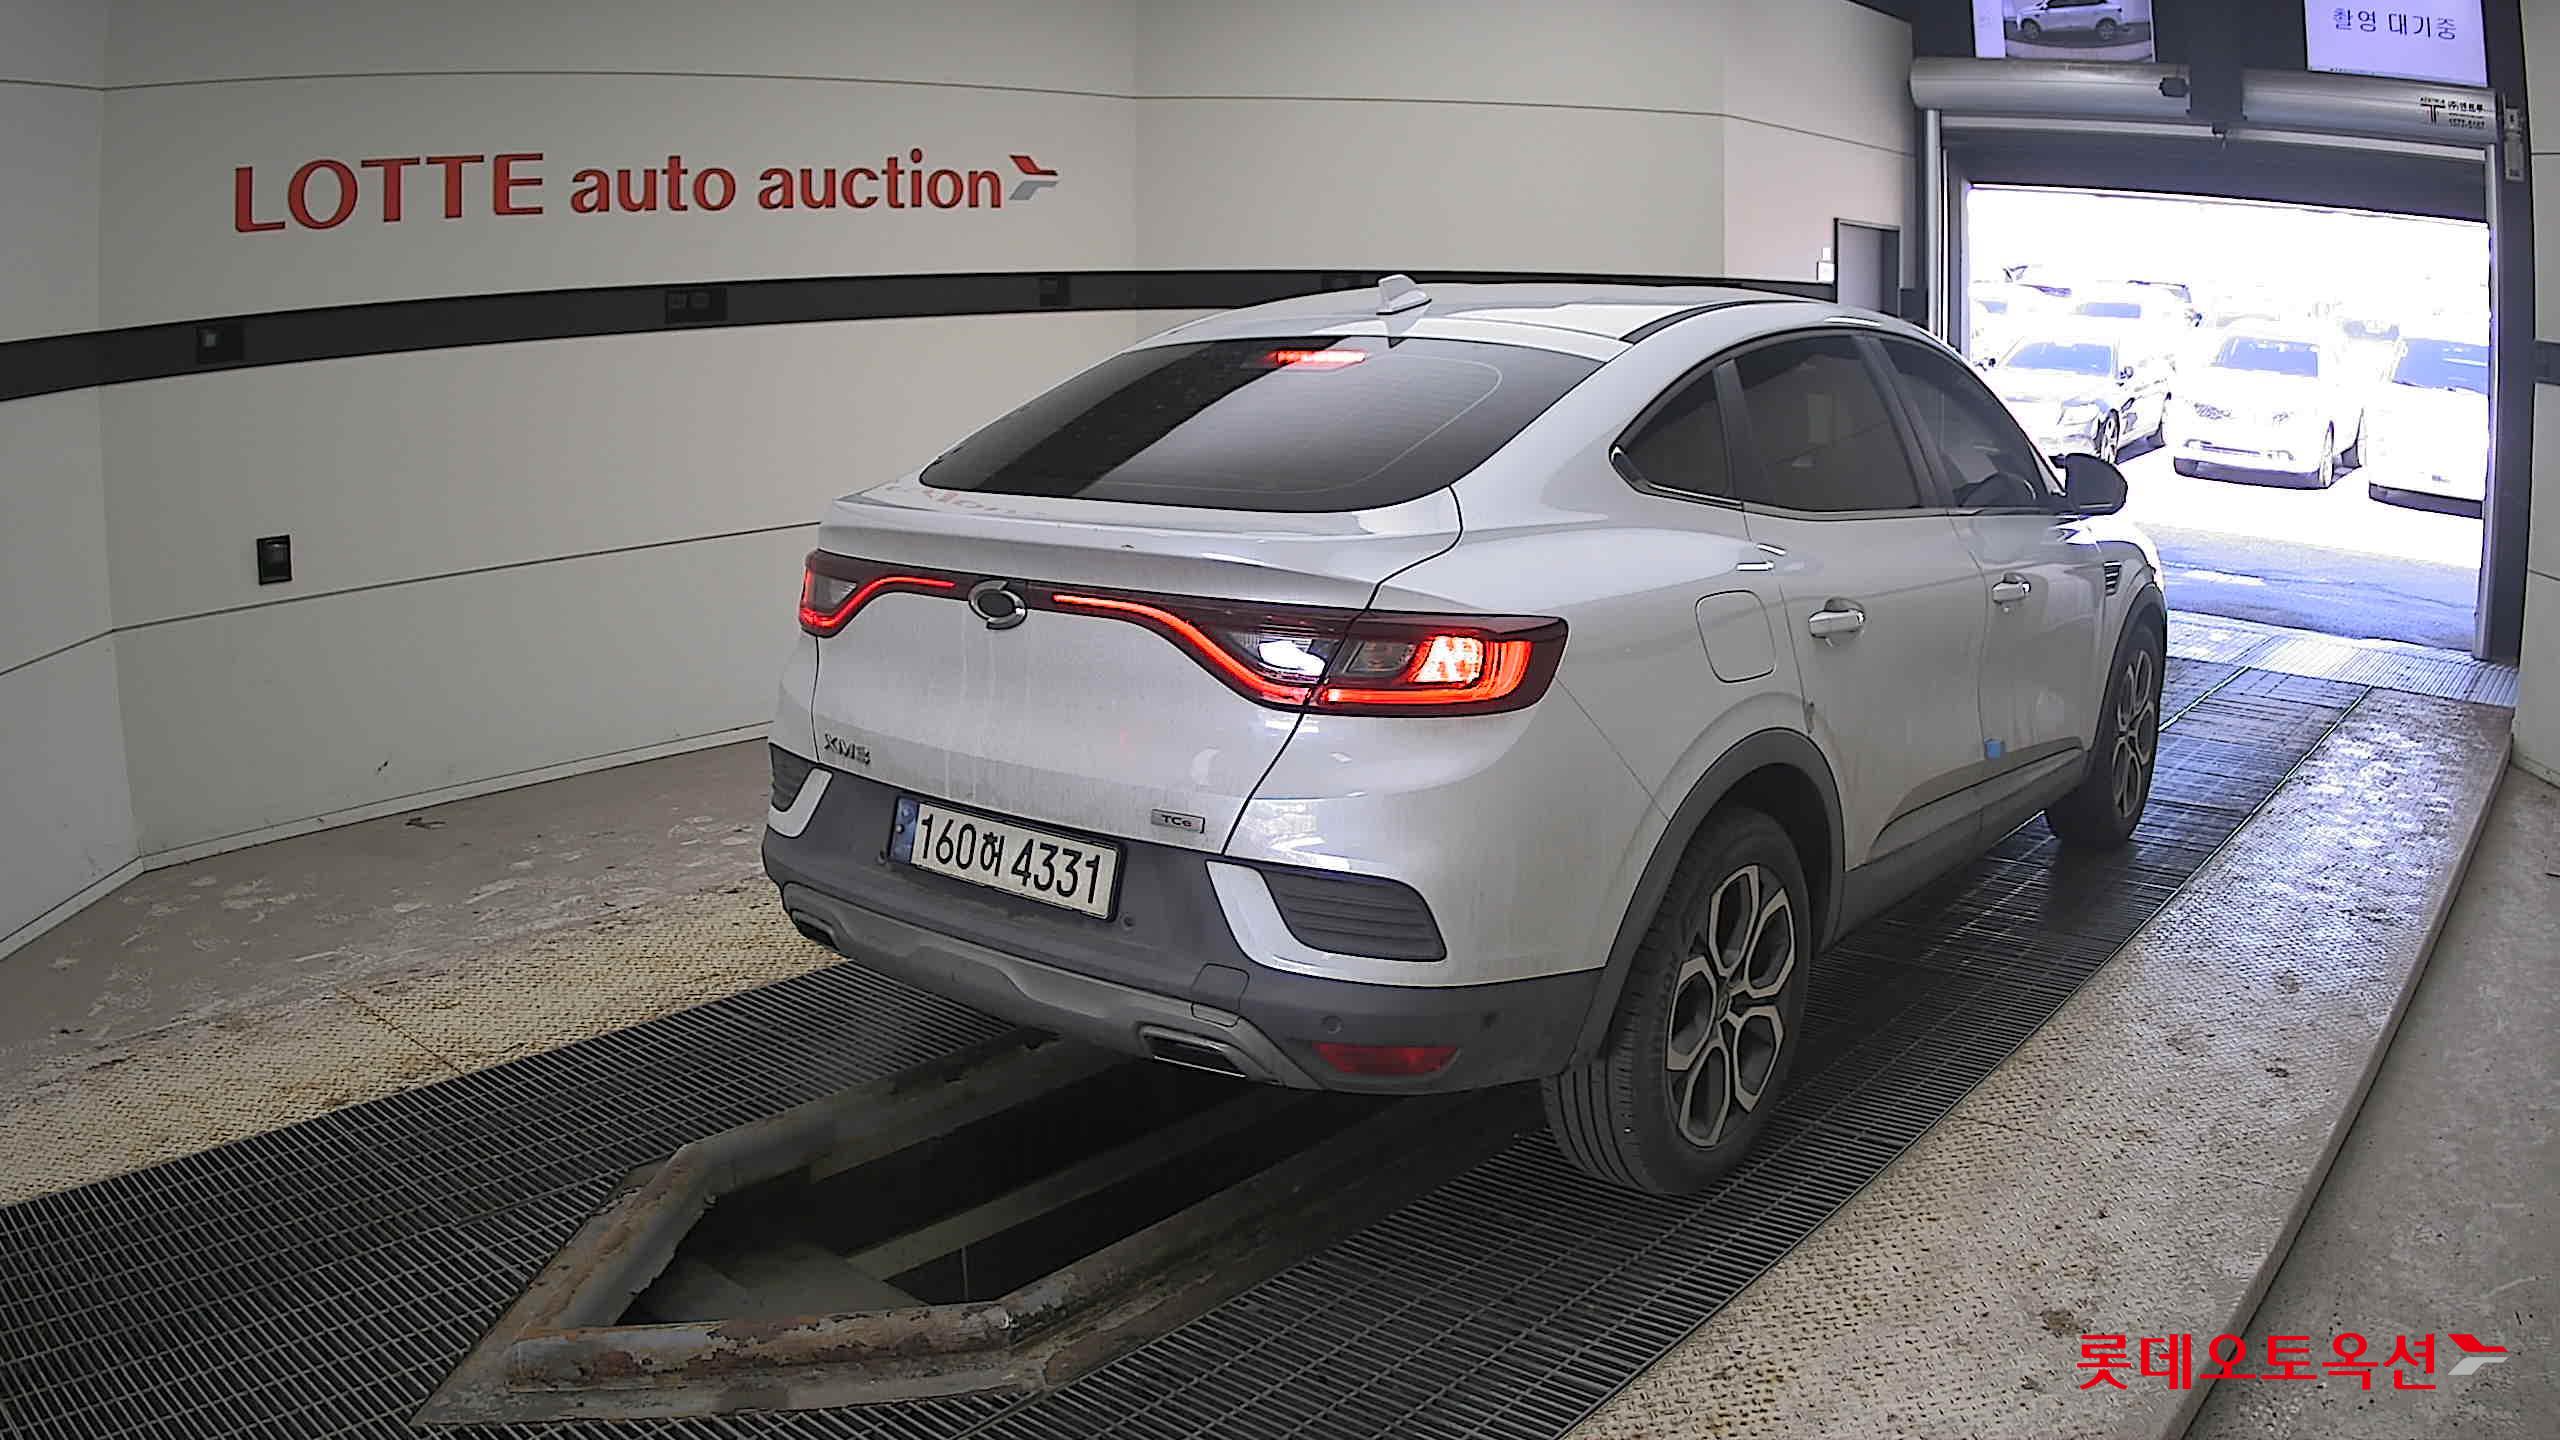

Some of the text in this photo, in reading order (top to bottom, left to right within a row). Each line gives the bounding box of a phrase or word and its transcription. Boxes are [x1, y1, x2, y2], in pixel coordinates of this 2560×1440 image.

[2388, 13, 2456, 40] 대기중
[235, 148, 1004, 233] LOTTE auto auction
[921, 813, 1101, 905] 160허 4331
